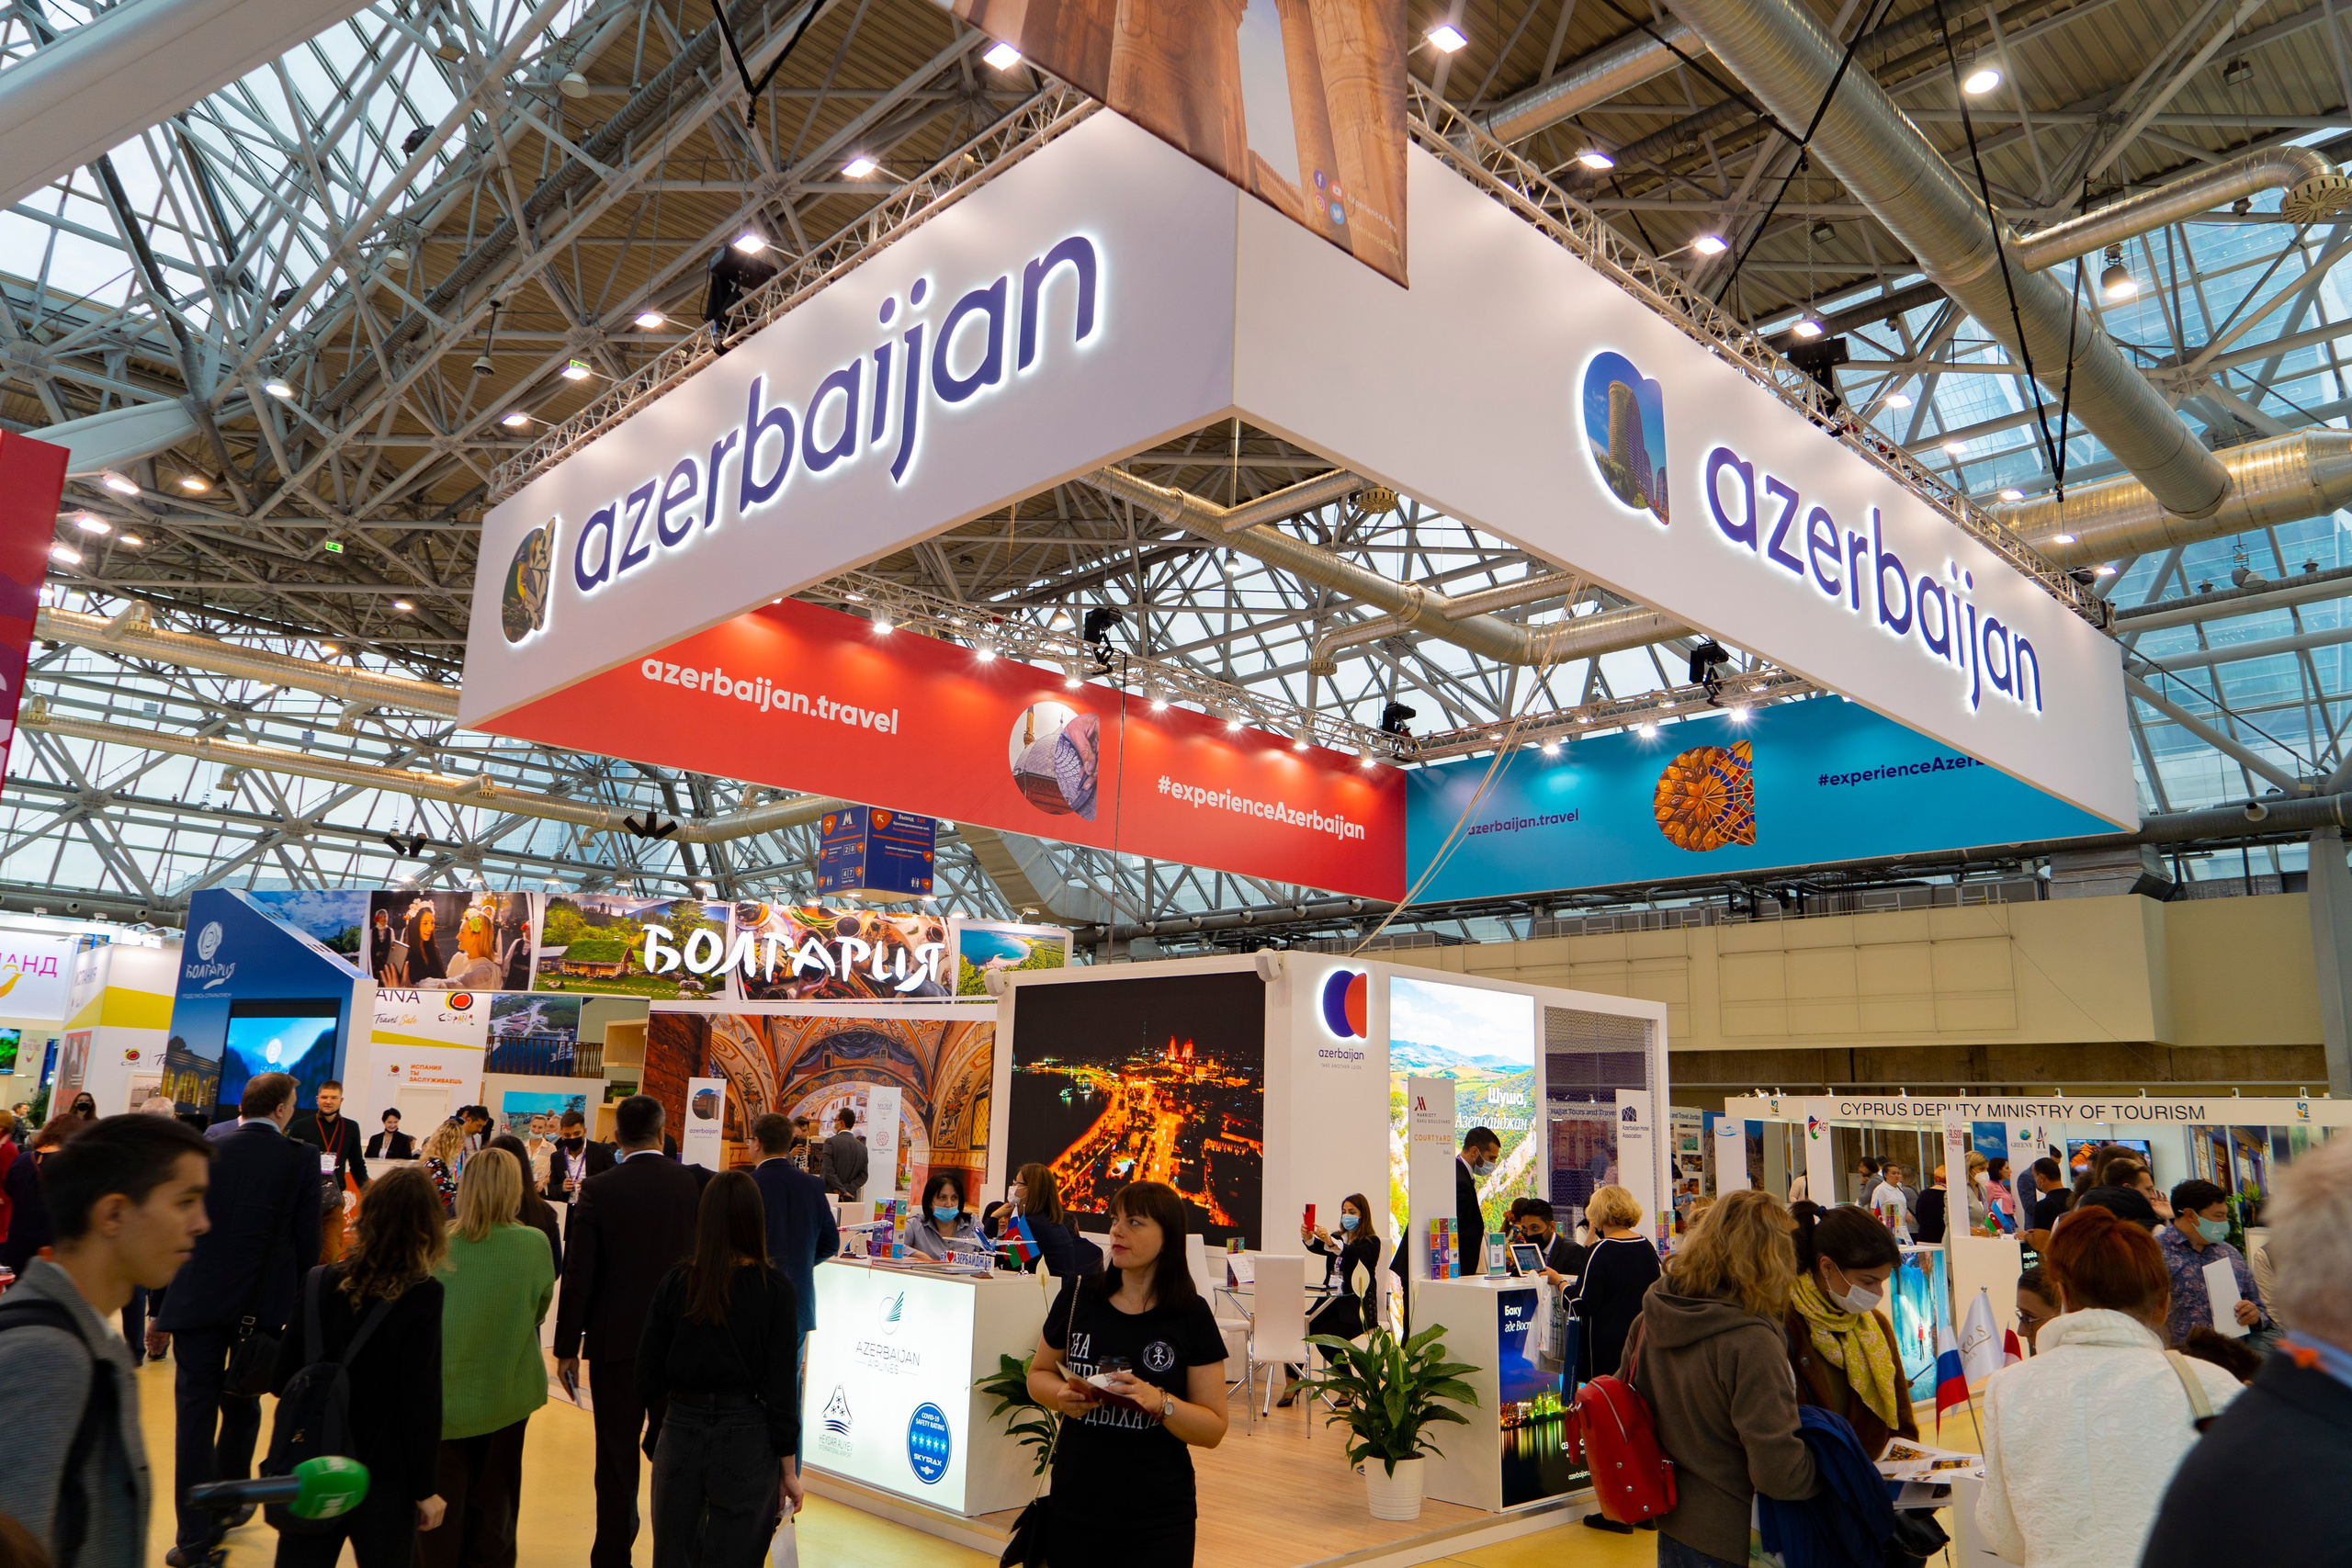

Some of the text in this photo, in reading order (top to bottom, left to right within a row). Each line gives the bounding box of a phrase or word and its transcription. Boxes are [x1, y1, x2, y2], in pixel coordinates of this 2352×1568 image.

[574, 235, 1097, 592] azerbaijan
[1706, 447, 2042, 712] azerbaijan
[641, 659, 899, 735] azerbaijan.travel
[1158, 775, 1364, 840] #experienceAzerbaijan
[898, 814, 914, 823] Выход
[1467, 808, 1578, 835] azerbaijan.travel
[0, 952, 58, 978] АНД
[640, 924, 945, 993] БОЛГАРИЯ
[186, 963, 236, 979] БОЛГАРИЯ
[374, 1013, 418, 1026] Travel Safe
[1318, 1048, 1364, 1062] azerbaijan
[409, 1077, 462, 1085] ЗАСЛУЖИВАЕШЬ
[1488, 1088, 1527, 1108] Шуша,
[1840, 1102, 1907, 1116] CYPRUS
[2080, 1105, 2106, 1119] OF
[2111, 1105, 2206, 1120] TOURISM
[1455, 1112, 1528, 1130] Азербайджан
[1414, 1134, 1452, 1142] COURTYARD
[1504, 1305, 1521, 1317] Баку
[1505, 1320, 1516, 1333] где
[855, 1341, 920, 1366] AZERBAIJAN
[915, 1418, 945, 1432] SAFETY RATING
[922, 1412, 940, 1423] COVID-19
[913, 1453, 943, 1467] SKYTRAX
